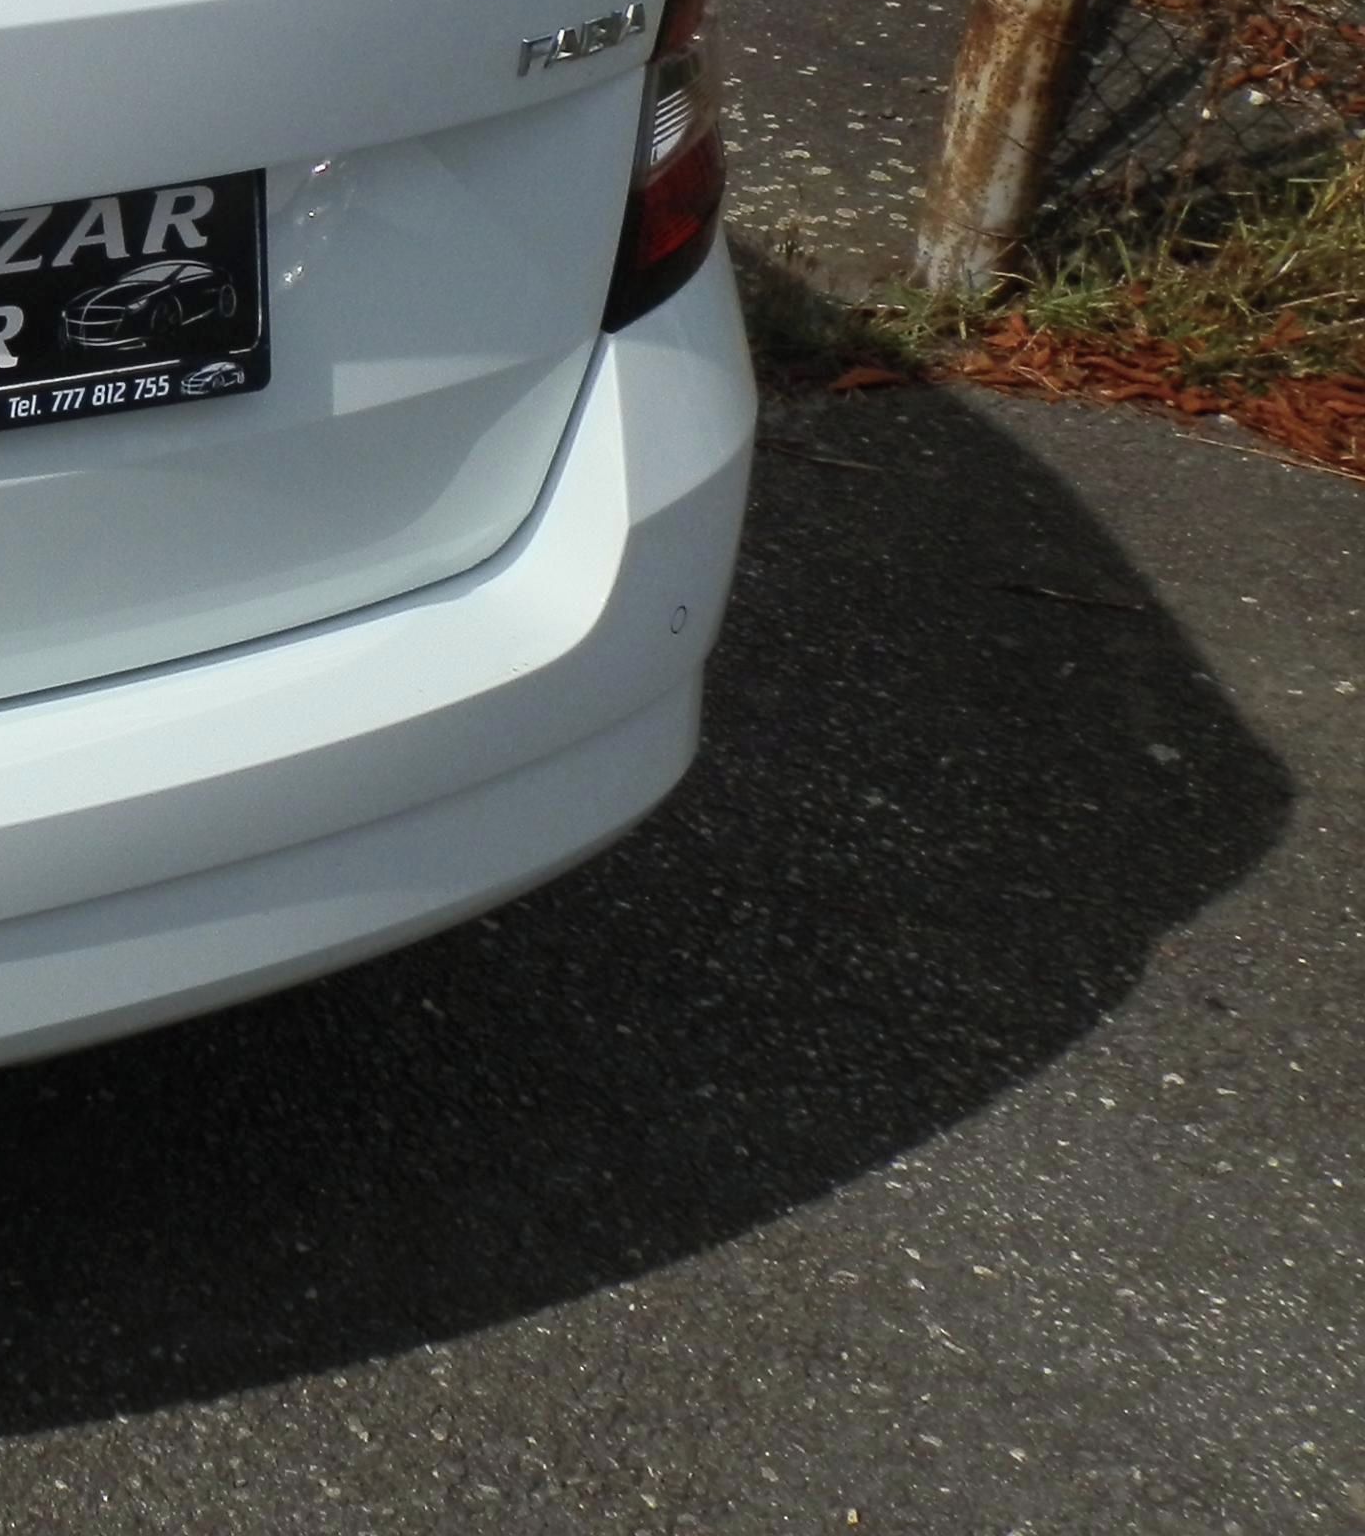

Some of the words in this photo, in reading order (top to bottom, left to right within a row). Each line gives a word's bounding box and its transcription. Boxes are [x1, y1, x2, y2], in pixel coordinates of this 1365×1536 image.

[9, 395, 42, 419] Tel.
[51, 388, 85, 413] 777
[91, 381, 126, 408] 812
[134, 375, 170, 401] 755
